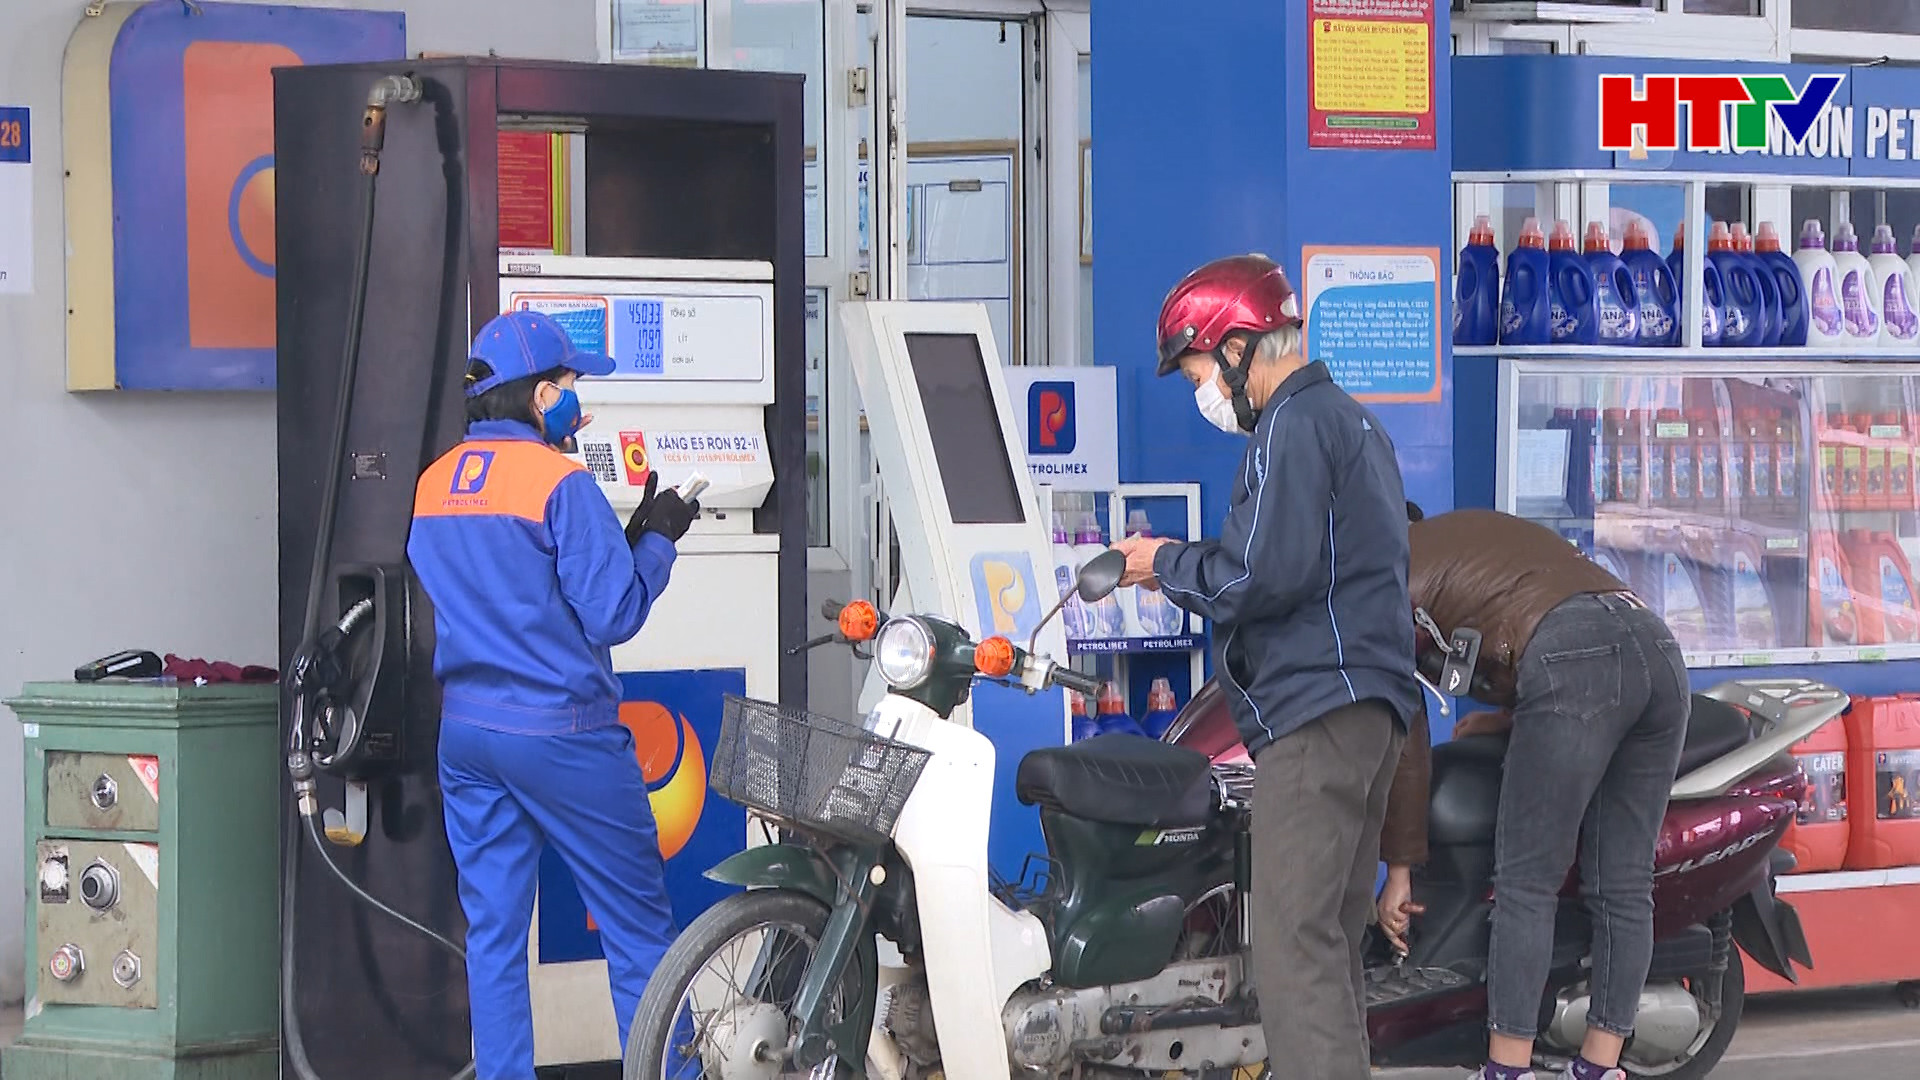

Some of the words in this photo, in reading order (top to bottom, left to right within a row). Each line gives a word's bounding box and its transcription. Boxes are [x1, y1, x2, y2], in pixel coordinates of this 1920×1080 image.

[1349, 269, 1376, 280] THÔNG
[629, 303, 661, 324] 45033
[634, 353, 661, 368] 25060
[656, 436, 688, 450] XĂNG
[707, 437, 732, 450] RON
[1077, 641, 1128, 650] PETROLIMEX
[1143, 639, 1193, 648] PETROLIMEX
[1164, 833, 1199, 842] HONDA
